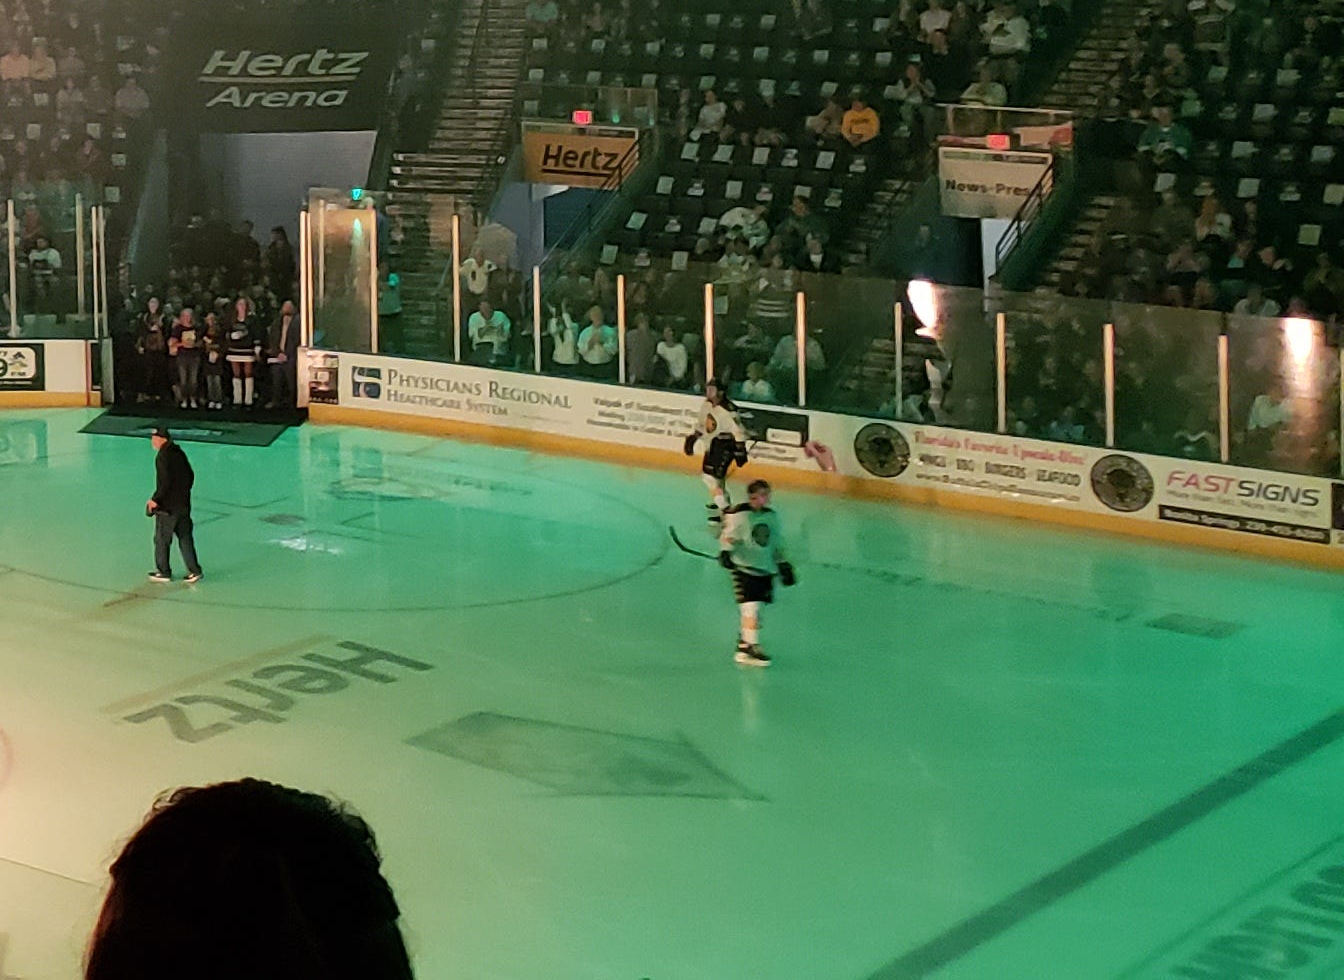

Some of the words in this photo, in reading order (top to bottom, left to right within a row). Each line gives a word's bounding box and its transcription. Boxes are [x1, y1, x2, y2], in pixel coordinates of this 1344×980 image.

[201, 48, 370, 77] Hertz
[205, 86, 350, 108] Arena
[542, 143, 620, 171] Hertz
[488, 380, 574, 410] REGIONAL
[123, 638, 436, 744] Hertz
